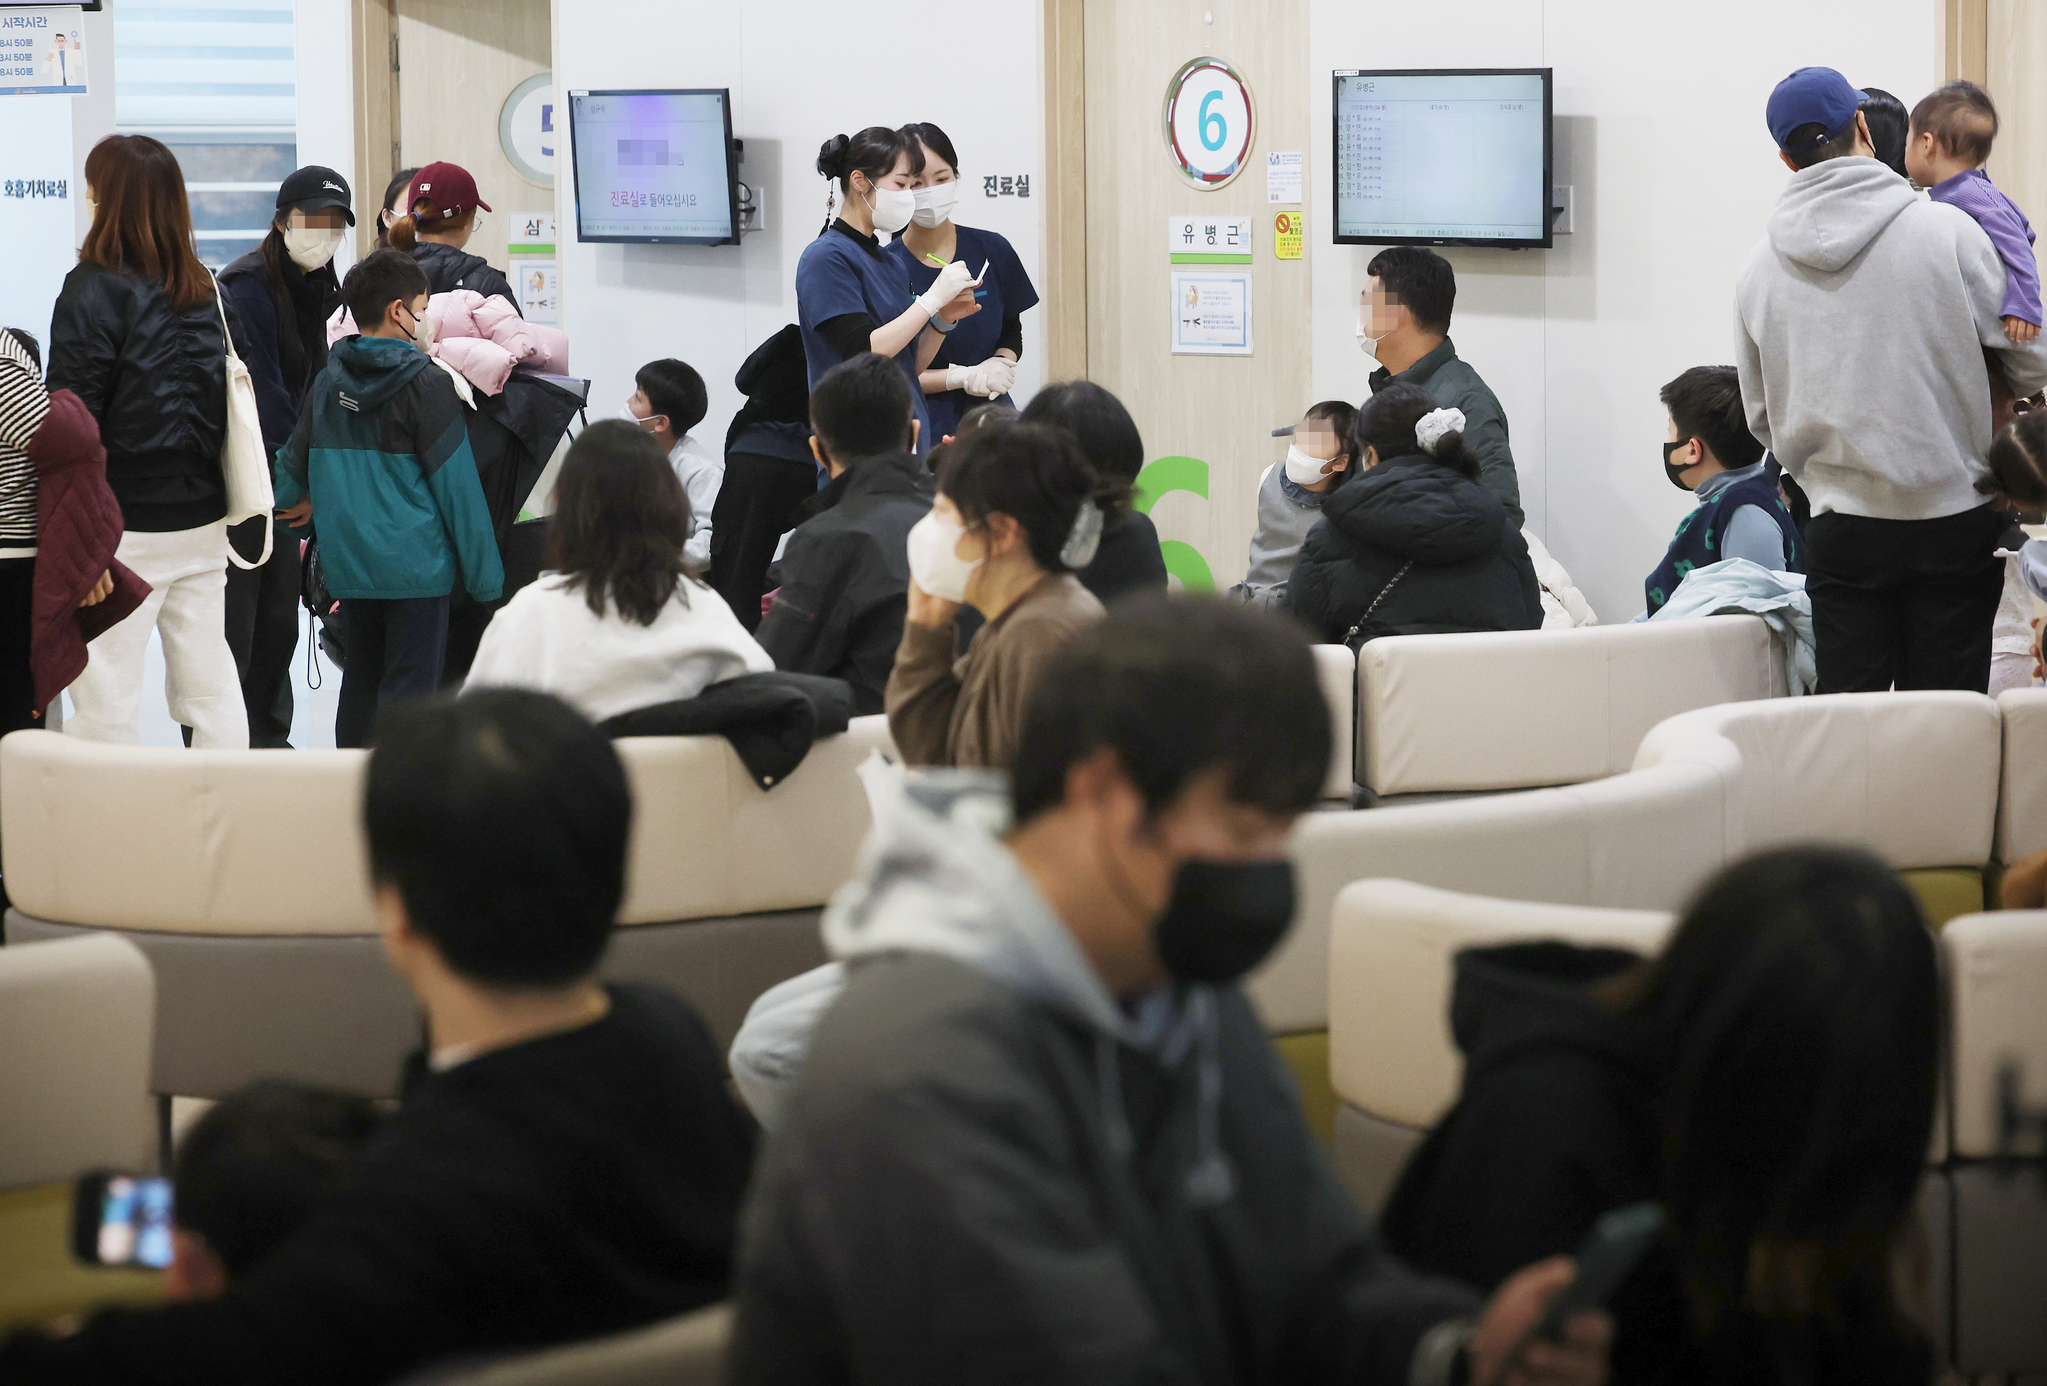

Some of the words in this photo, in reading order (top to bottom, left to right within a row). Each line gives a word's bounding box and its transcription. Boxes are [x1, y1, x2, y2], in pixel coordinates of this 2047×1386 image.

[2, 16, 48, 29] 시작시간
[14, 38, 34, 47] 50분
[13, 53, 33, 62] 50분
[14, 67, 34, 76] 50분
[1356, 82, 1375, 92] 유병근
[1198, 90, 1228, 152] 6
[3, 179, 67, 199] 호흡기치료실
[983, 174, 1030, 199] 진료실
[610, 190, 648, 208] 진료실로
[649, 193, 698, 208] 들어오십시요
